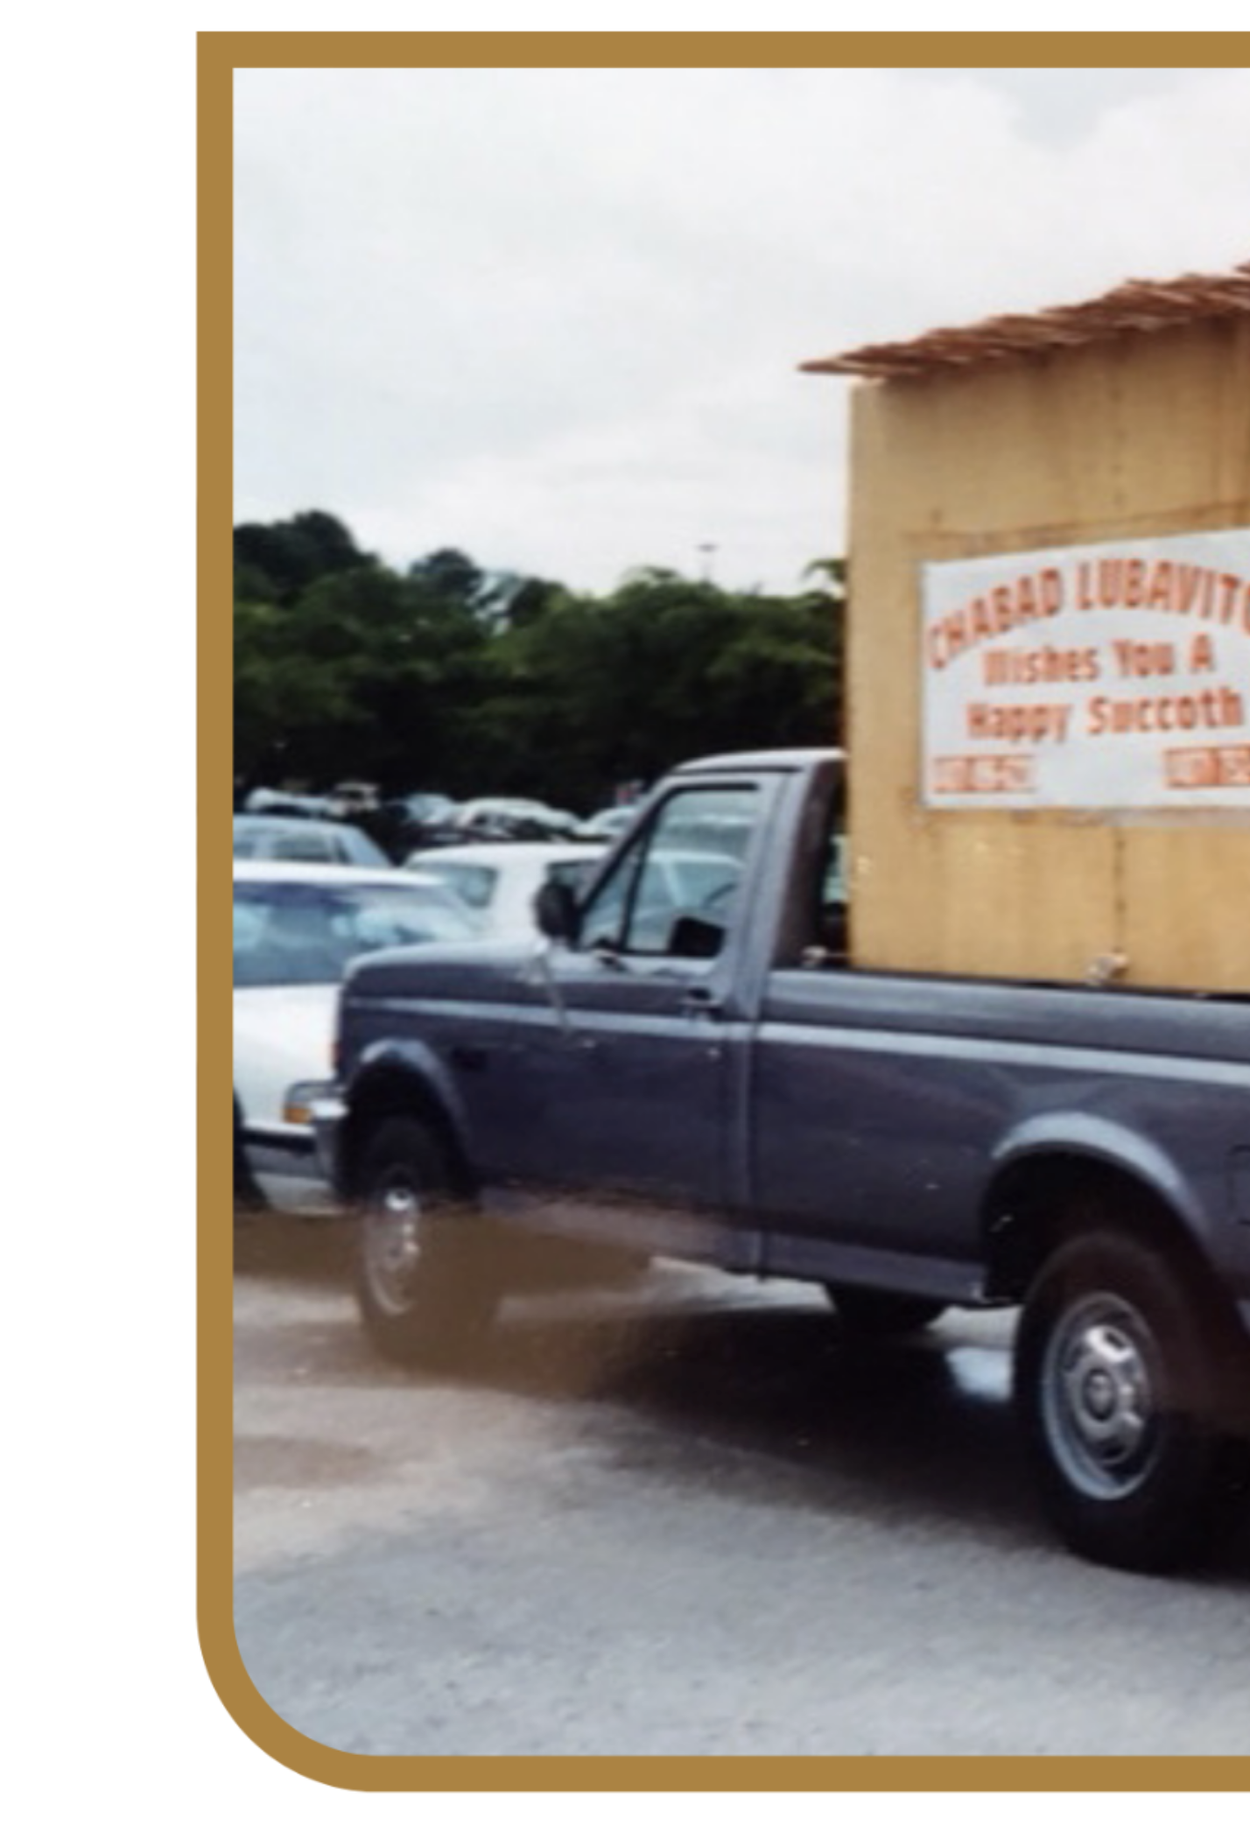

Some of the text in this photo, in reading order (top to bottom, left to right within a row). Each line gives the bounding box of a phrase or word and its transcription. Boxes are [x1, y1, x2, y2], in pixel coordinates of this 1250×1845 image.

[928, 568, 1064, 670] CHABAD
[983, 632, 1214, 686] Wishes You A
[966, 687, 1244, 744] Happy Succoth
